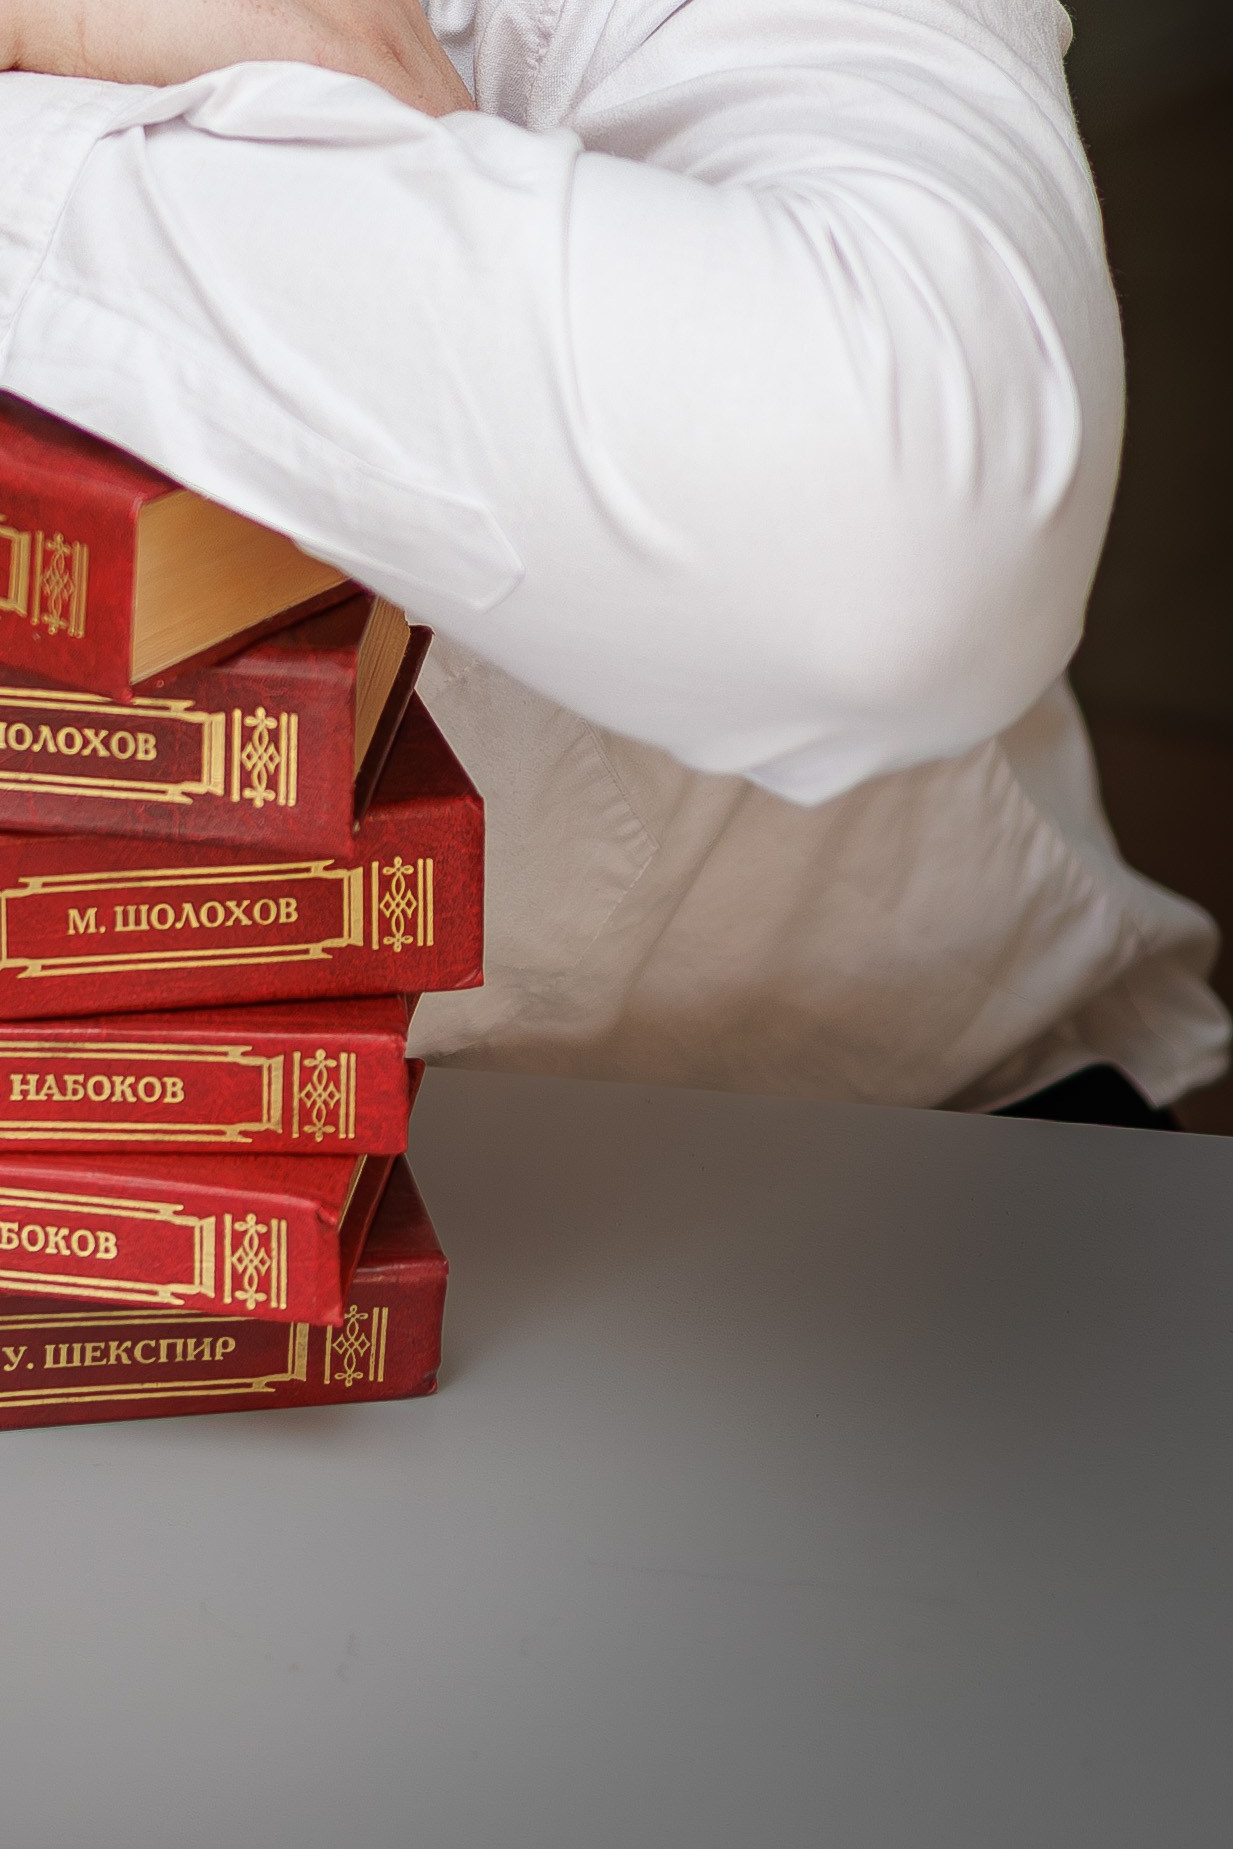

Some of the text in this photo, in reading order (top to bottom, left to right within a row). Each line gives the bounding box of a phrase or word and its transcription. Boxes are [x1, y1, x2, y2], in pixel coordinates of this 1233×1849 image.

[67, 897, 299, 936] М. ШОЛОХОВ
[9, 1073, 185, 1104] НАБОКОВ
[1, 1336, 236, 1372] У. ШЕКСПИР
